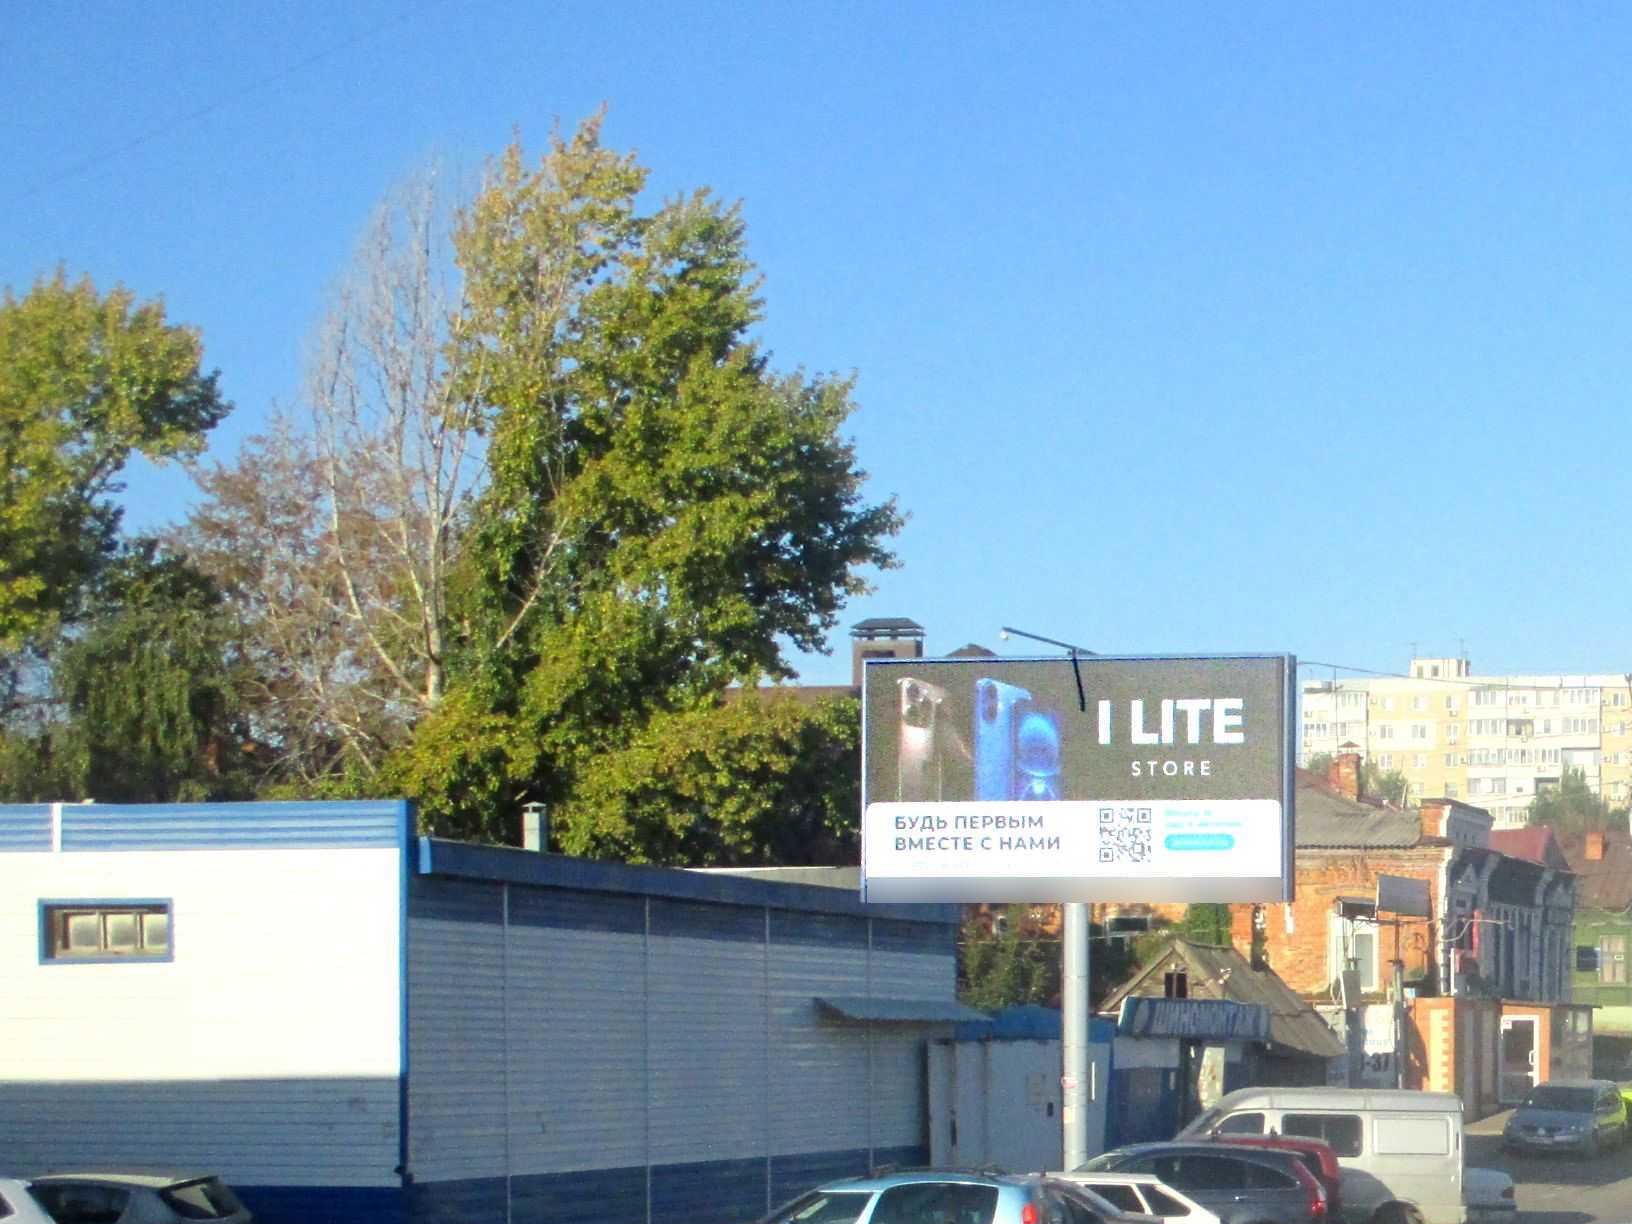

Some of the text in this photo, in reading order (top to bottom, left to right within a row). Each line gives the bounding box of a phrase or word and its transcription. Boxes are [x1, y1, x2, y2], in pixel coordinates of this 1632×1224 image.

[1098, 698, 1245, 744] I LITE
[1131, 760, 1212, 777] STORE
[895, 815, 1045, 832] БУДЬ ПЕРВЫМ
[895, 836, 1061, 851] ВМЕСТЕ С НАМИ
